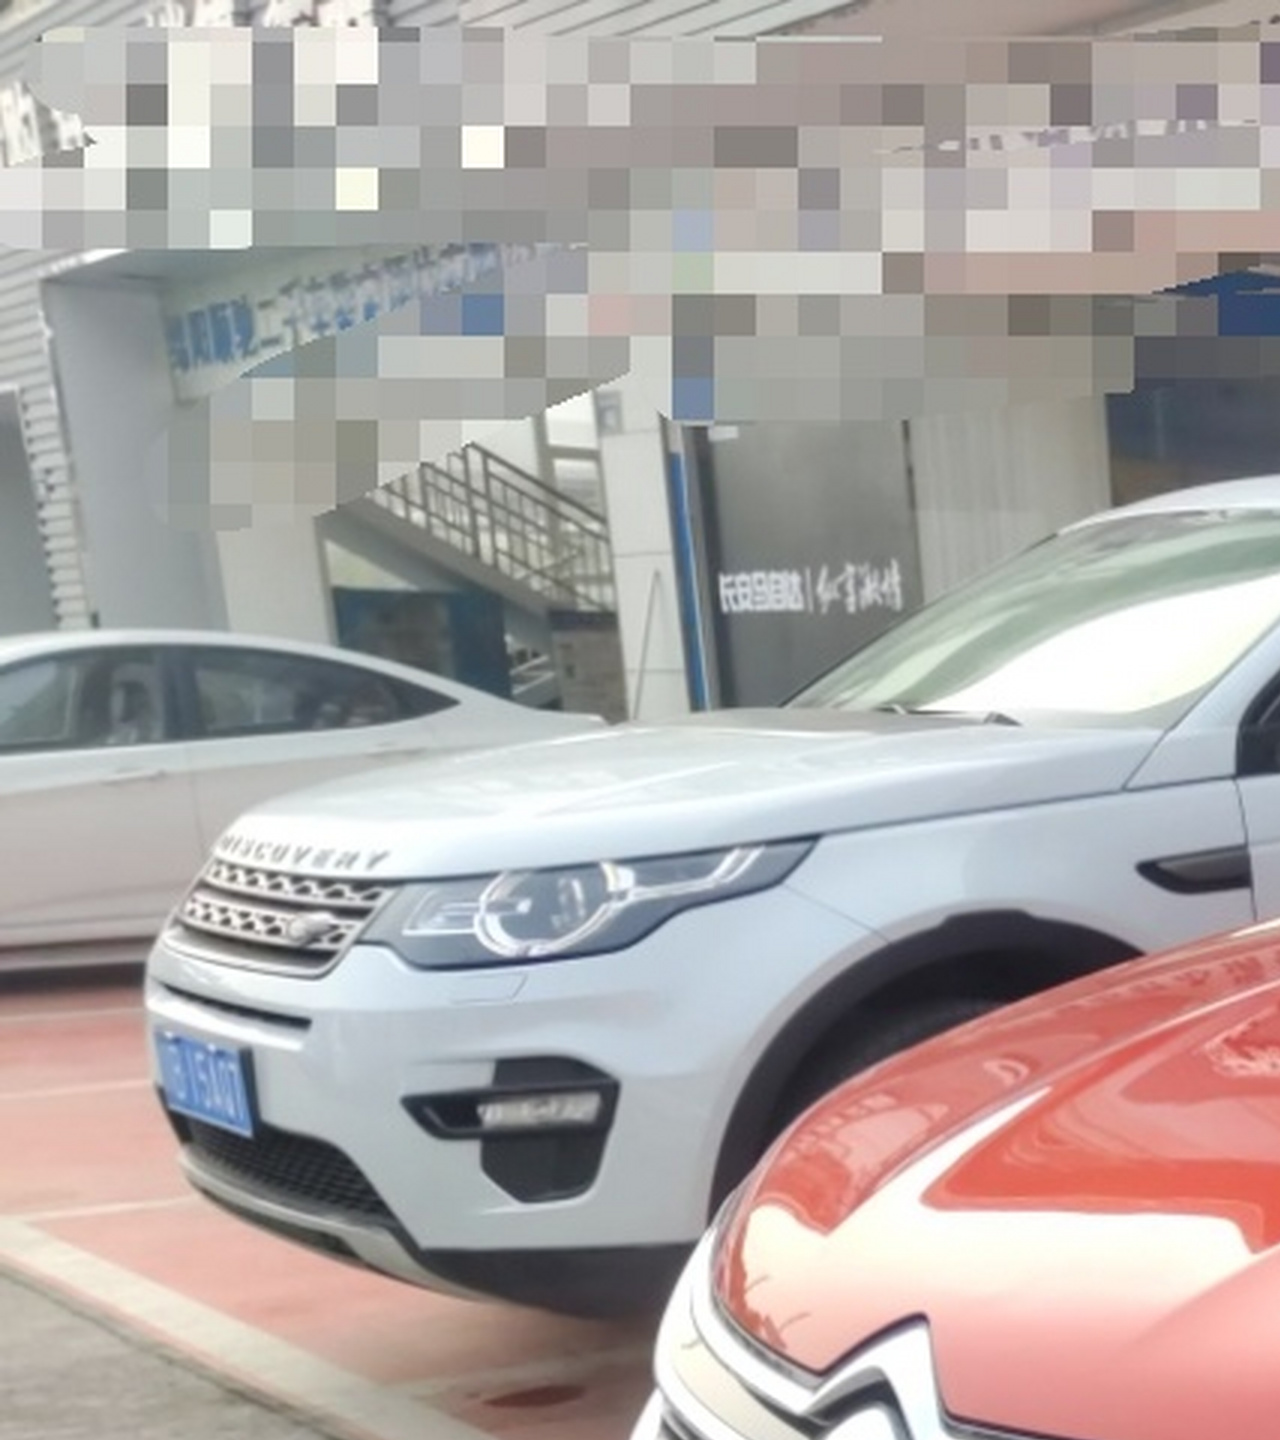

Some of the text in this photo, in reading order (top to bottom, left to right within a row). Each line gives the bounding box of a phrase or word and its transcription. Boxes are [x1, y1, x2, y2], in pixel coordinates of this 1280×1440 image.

[718, 568, 805, 614] 长安马自达
